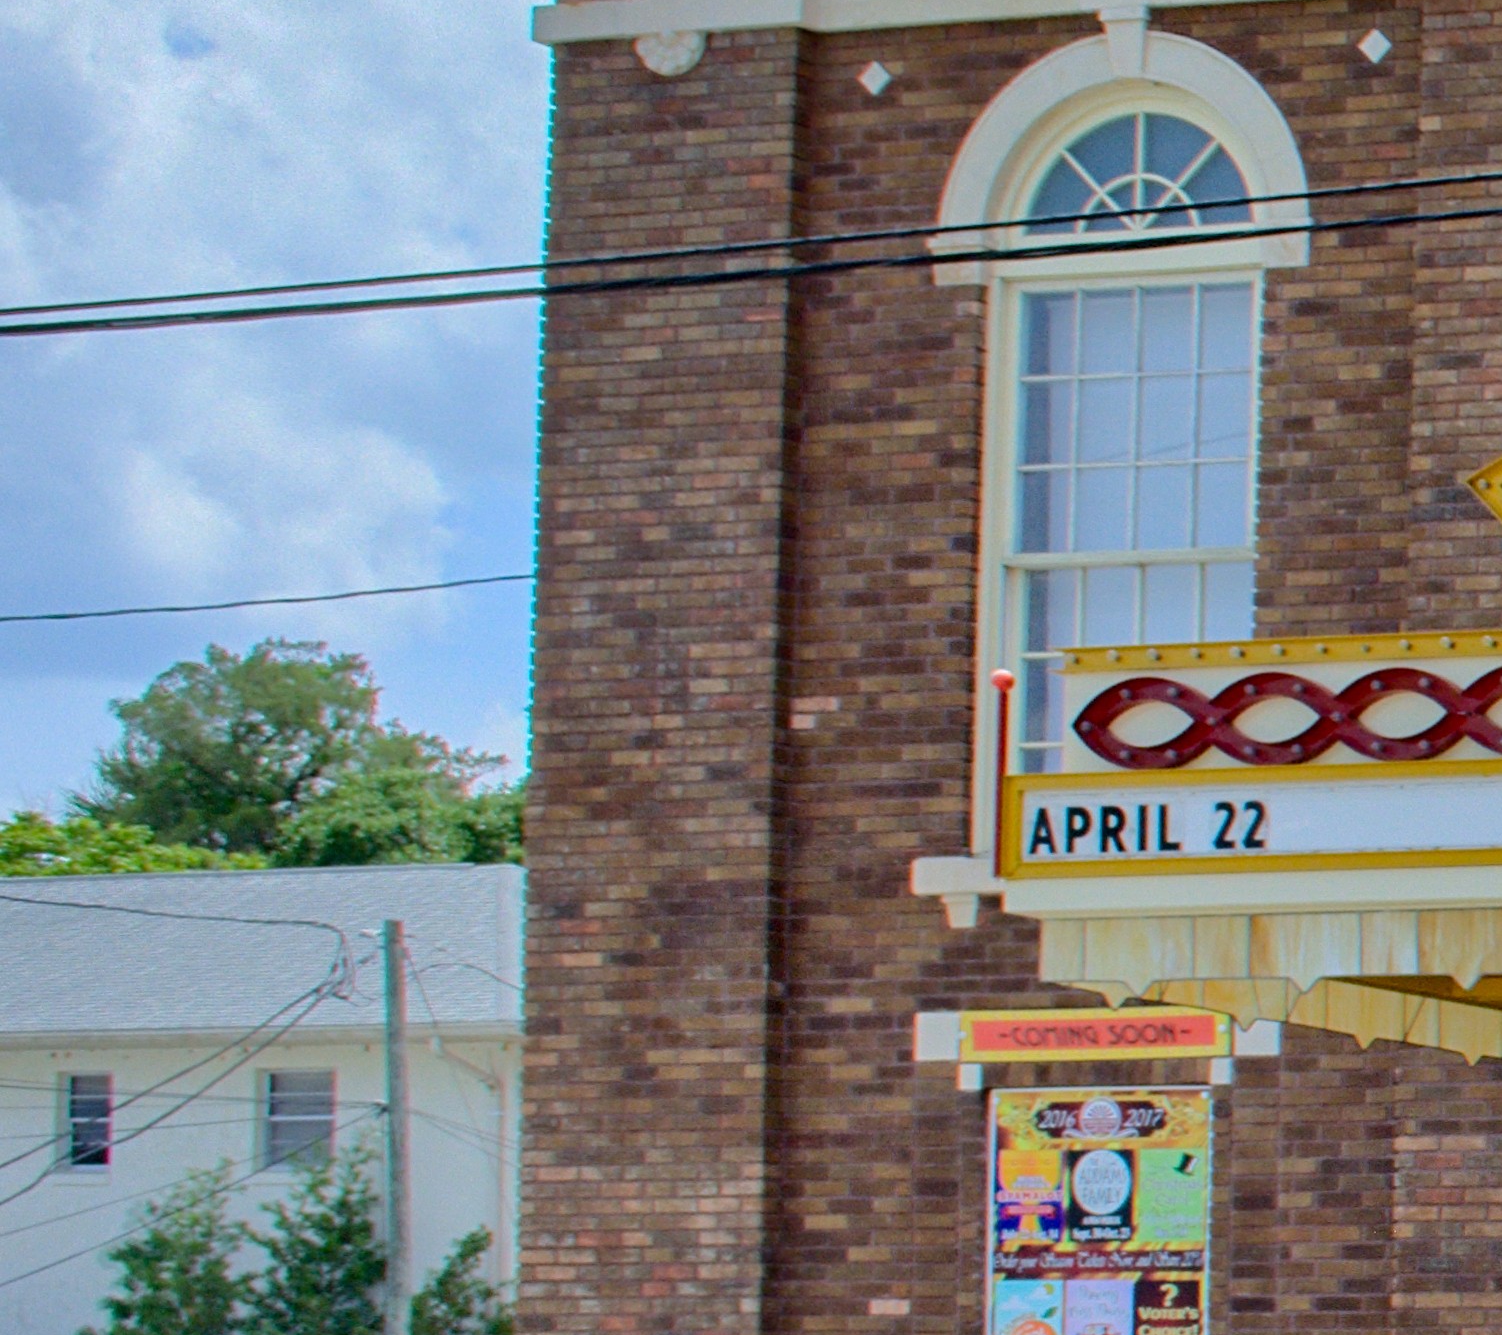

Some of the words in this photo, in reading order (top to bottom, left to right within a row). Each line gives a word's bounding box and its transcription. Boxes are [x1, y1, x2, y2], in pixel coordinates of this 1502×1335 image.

[1029, 804, 1182, 854] APRIL
[1214, 800, 1268, 849] 22
[1038, 1109, 1078, 1130] 2016
[1124, 1108, 1164, 1128] 2017
